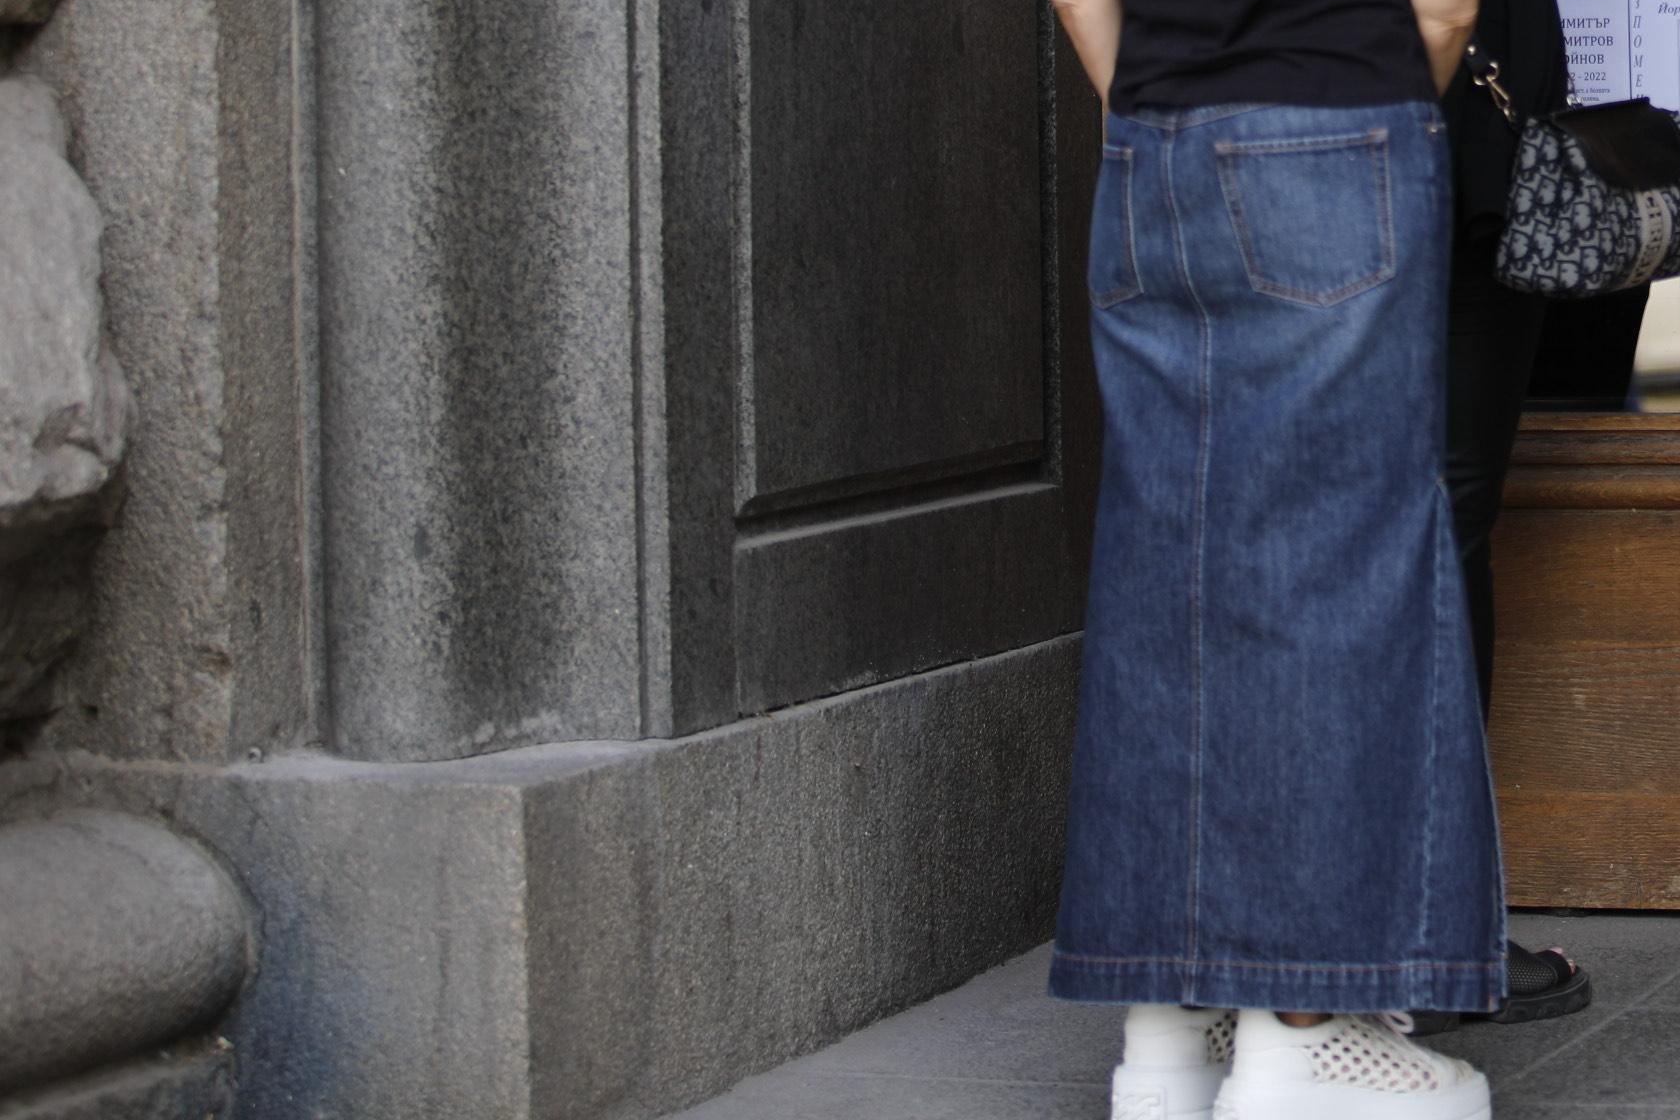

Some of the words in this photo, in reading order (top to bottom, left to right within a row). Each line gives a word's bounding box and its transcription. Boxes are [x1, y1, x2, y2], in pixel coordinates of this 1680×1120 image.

[1564, 36, 1614, 47] МИТРОВ
[1566, 52, 1605, 65] ОЙНОВ
[1584, 72, 1607, 81] 2022
